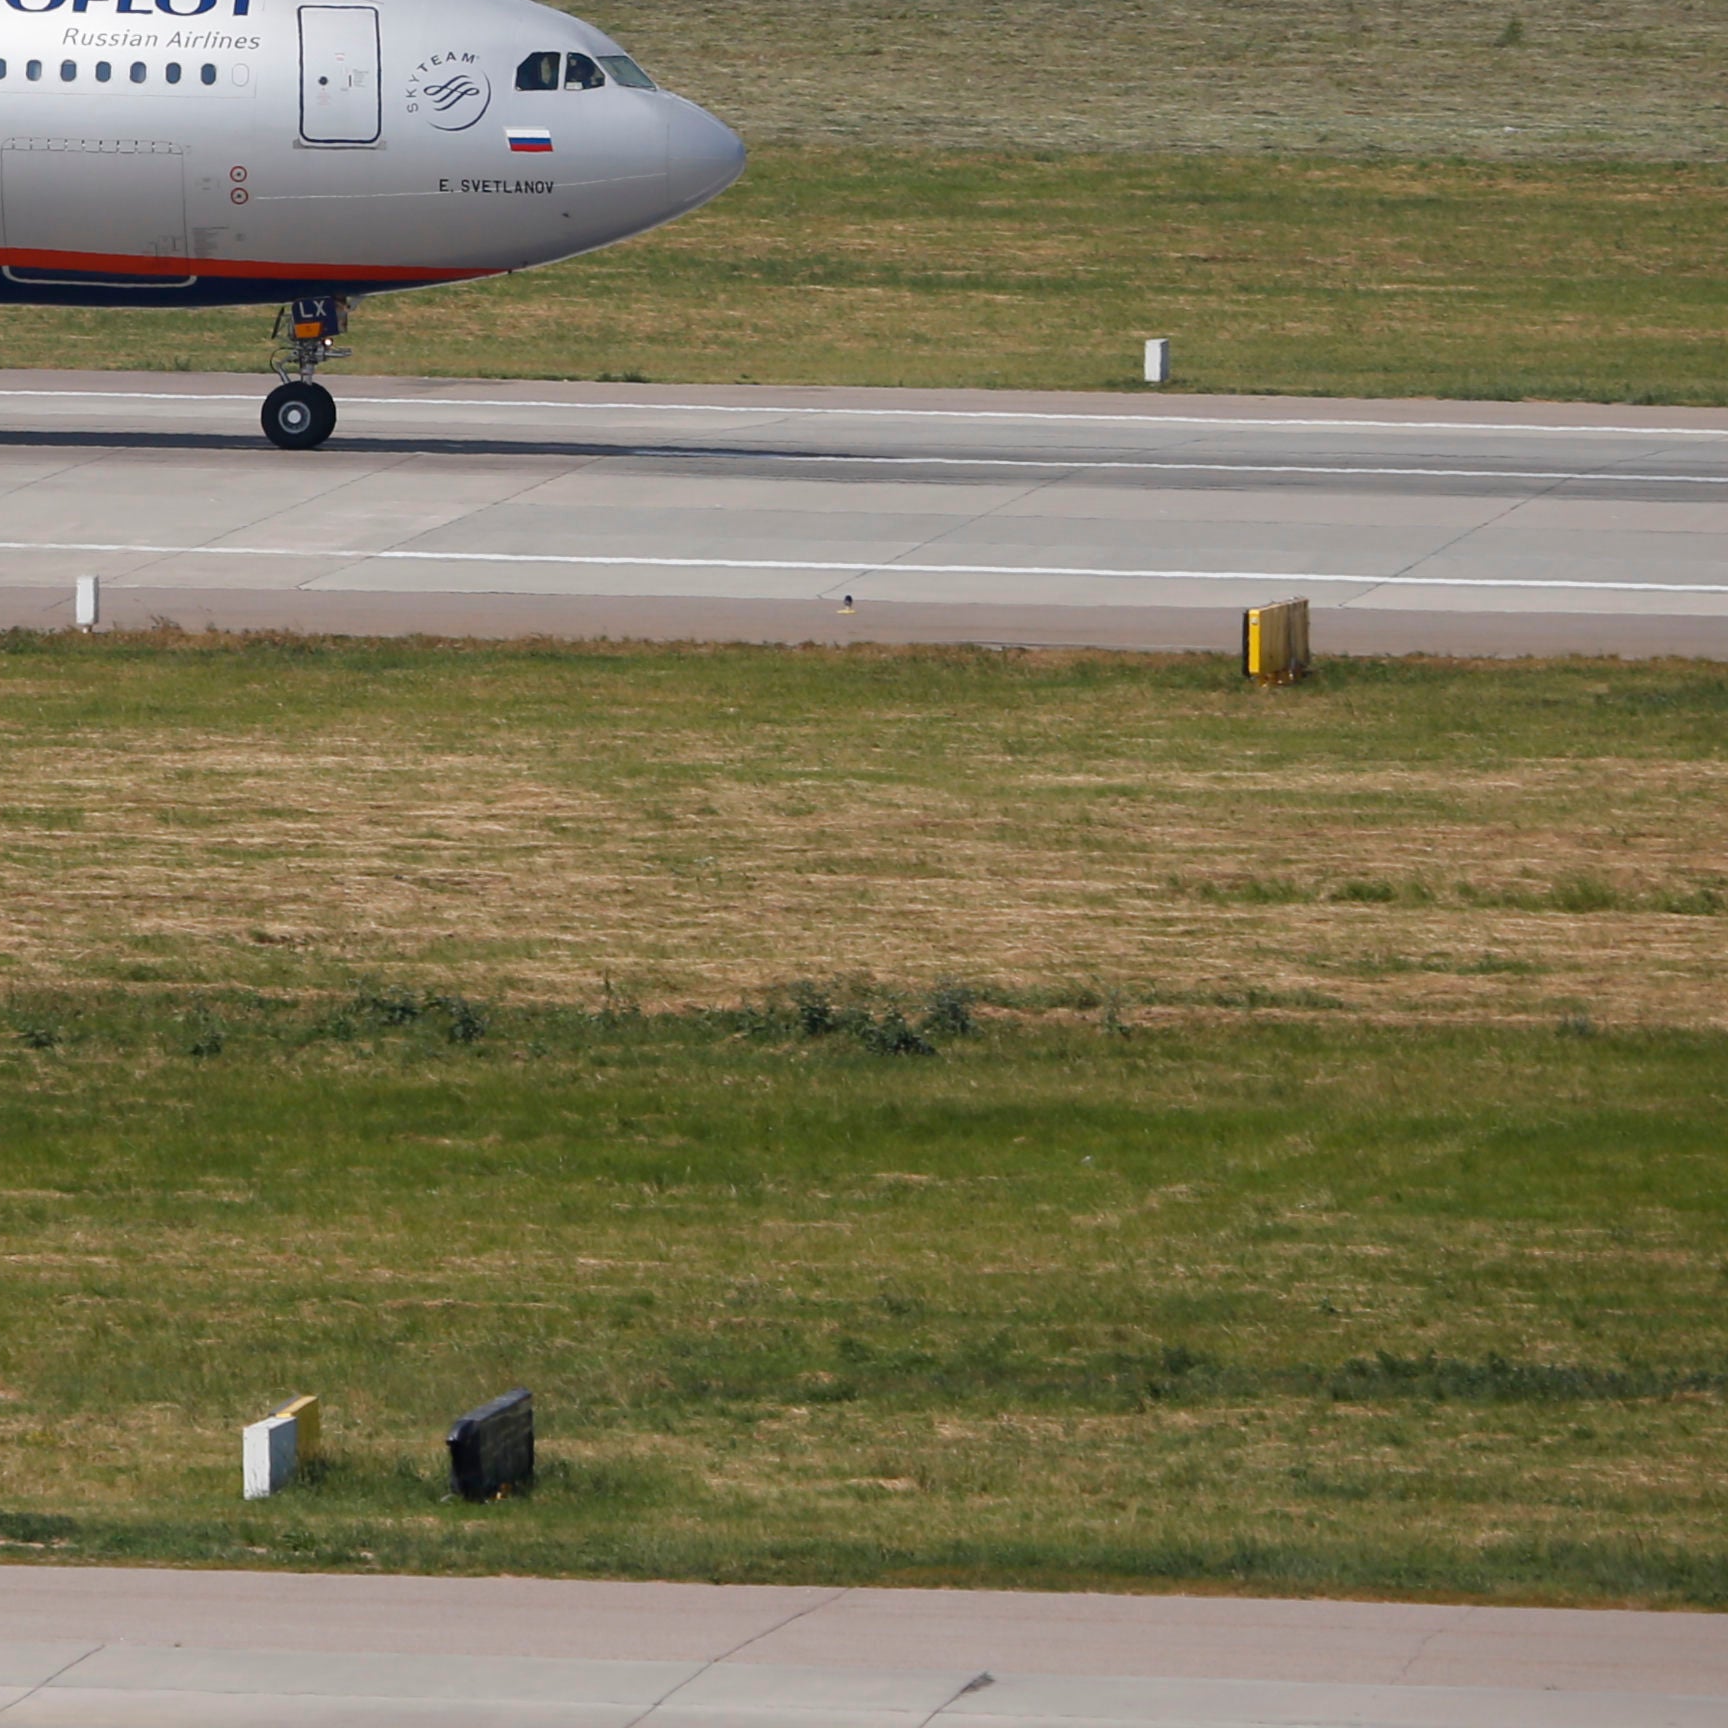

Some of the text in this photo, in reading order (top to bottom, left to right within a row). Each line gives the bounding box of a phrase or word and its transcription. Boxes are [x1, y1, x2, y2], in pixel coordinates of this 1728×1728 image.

[62, 27, 262, 50] Russian Airlines
[439, 178, 554, 194] E. SVETLANOV
[299, 300, 327, 318] LX
